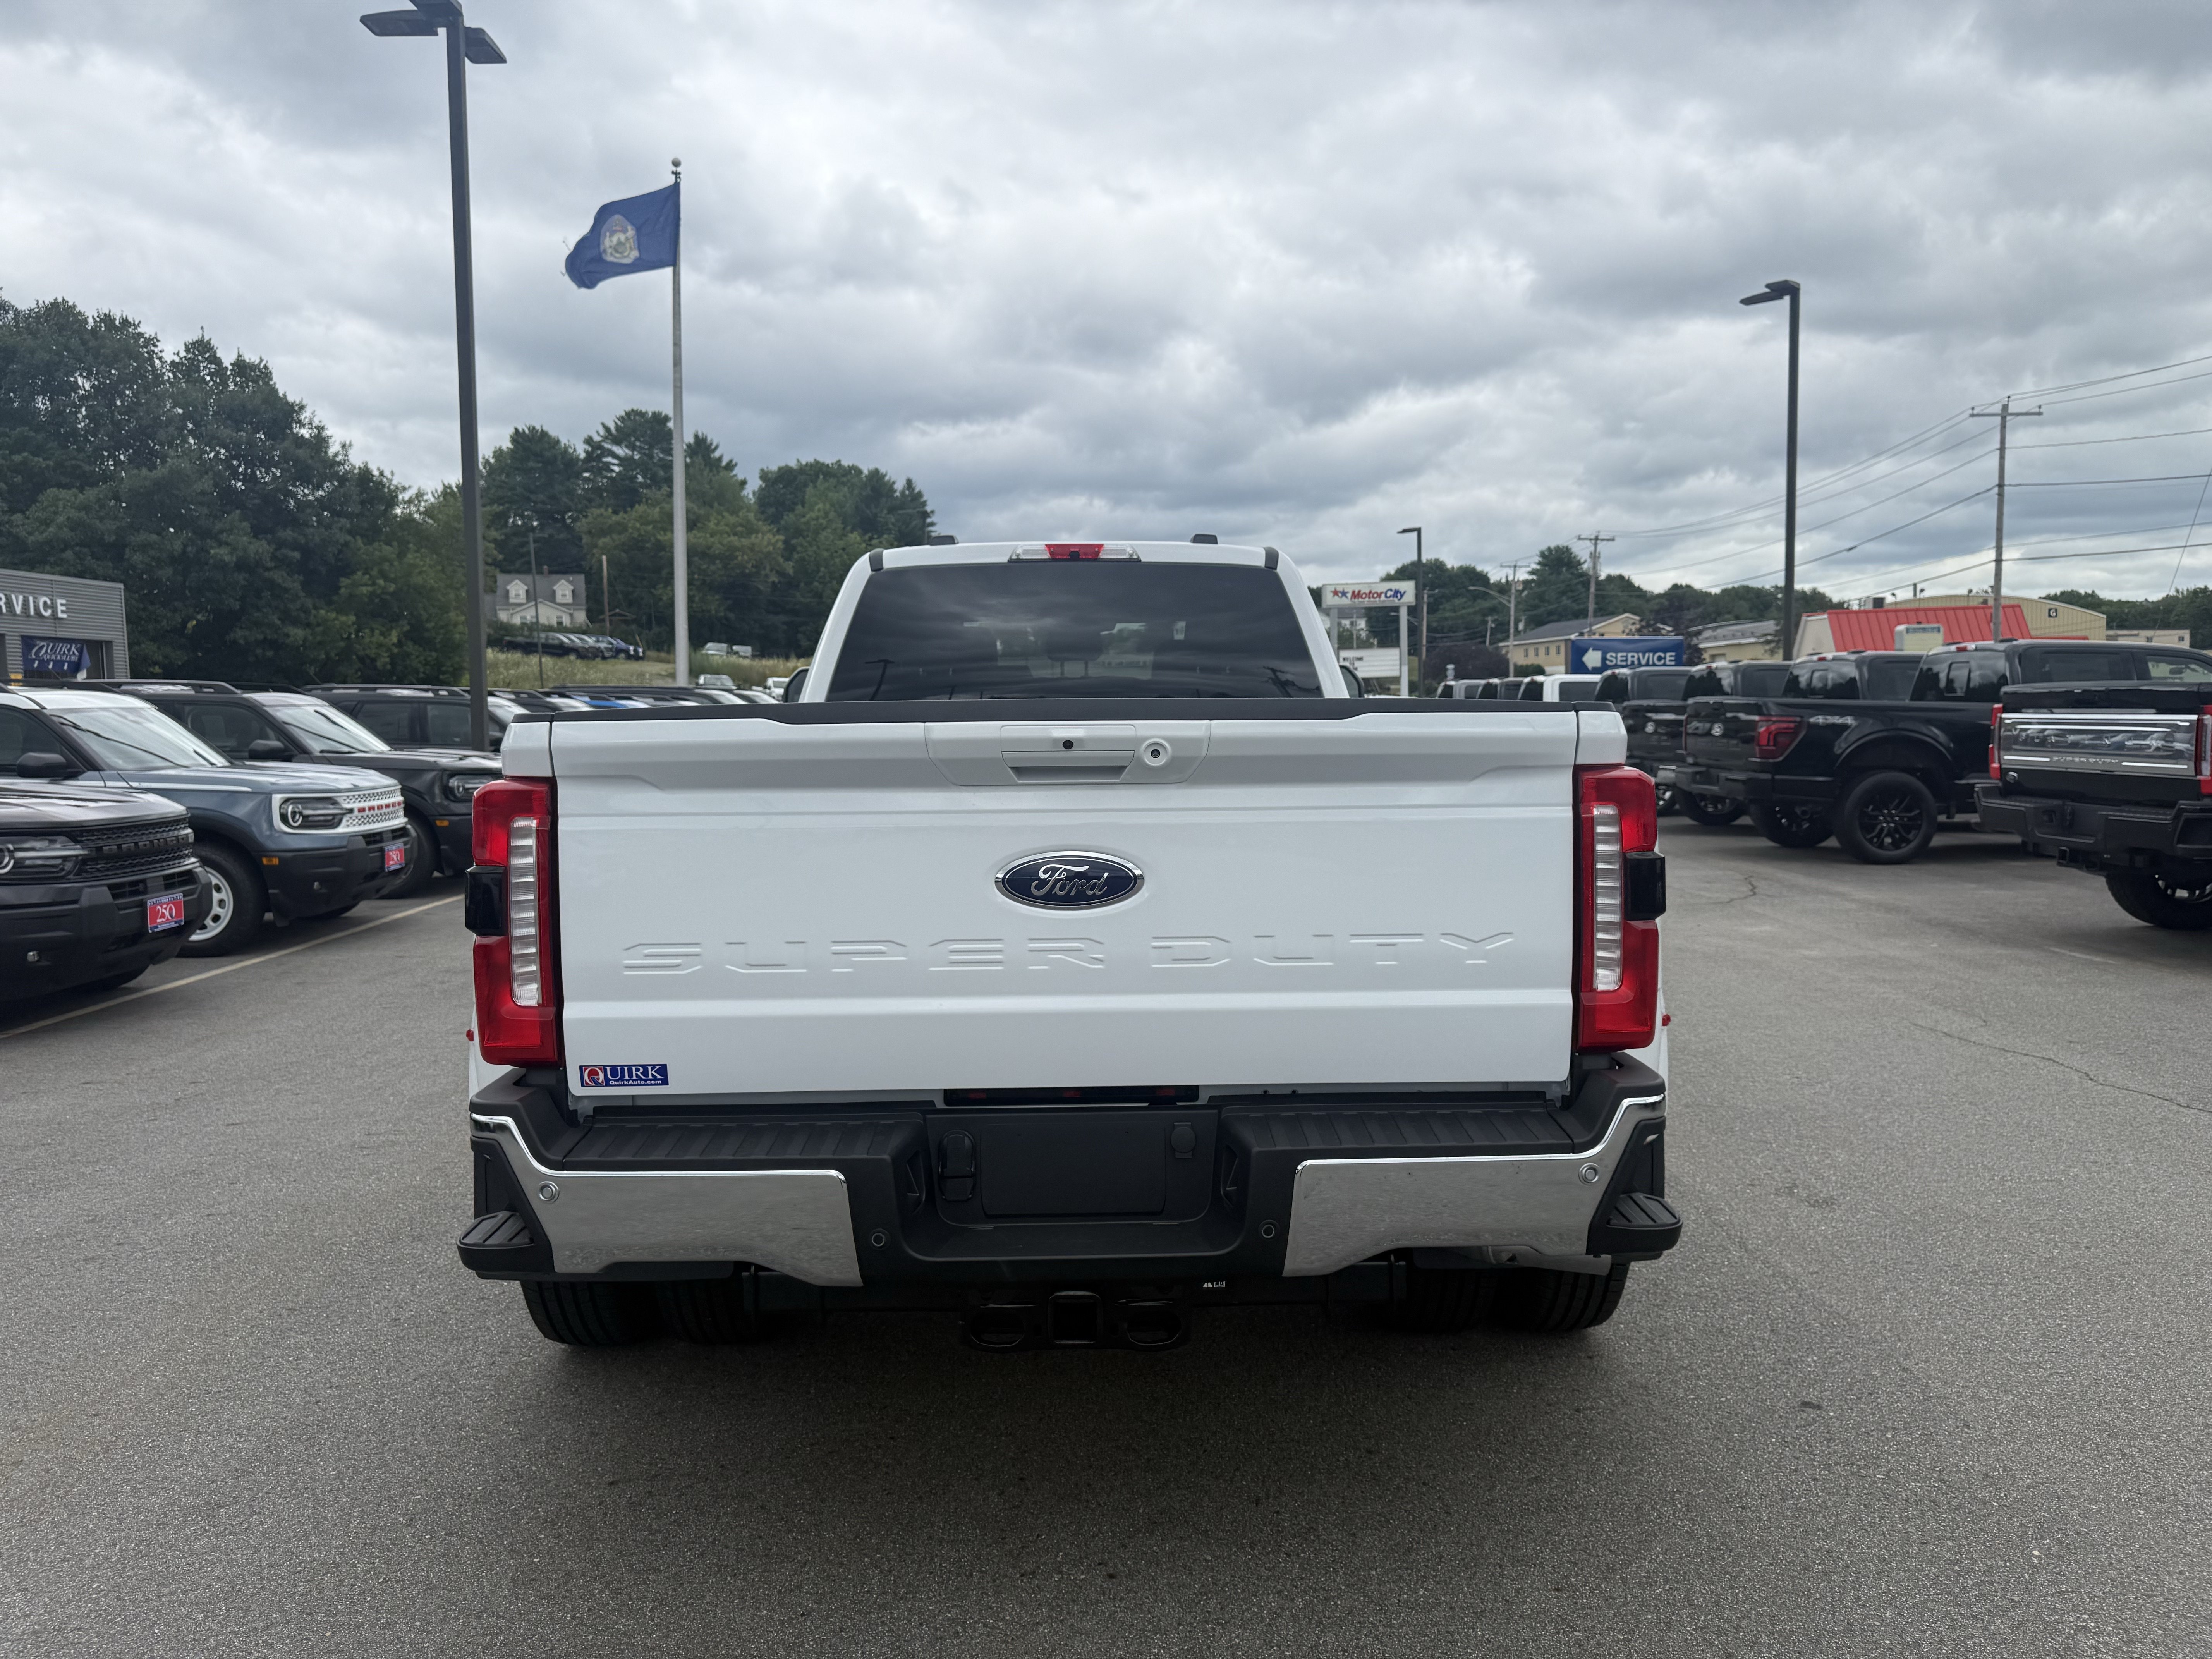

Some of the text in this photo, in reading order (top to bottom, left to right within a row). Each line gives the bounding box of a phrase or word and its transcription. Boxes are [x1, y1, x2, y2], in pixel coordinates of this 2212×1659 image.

[1606, 652, 1676, 665] SERVICE
[1031, 864, 1109, 896] Ford
[622, 932, 1514, 975] SUPER DUTY
[584, 1066, 665, 1085] QUIRK
